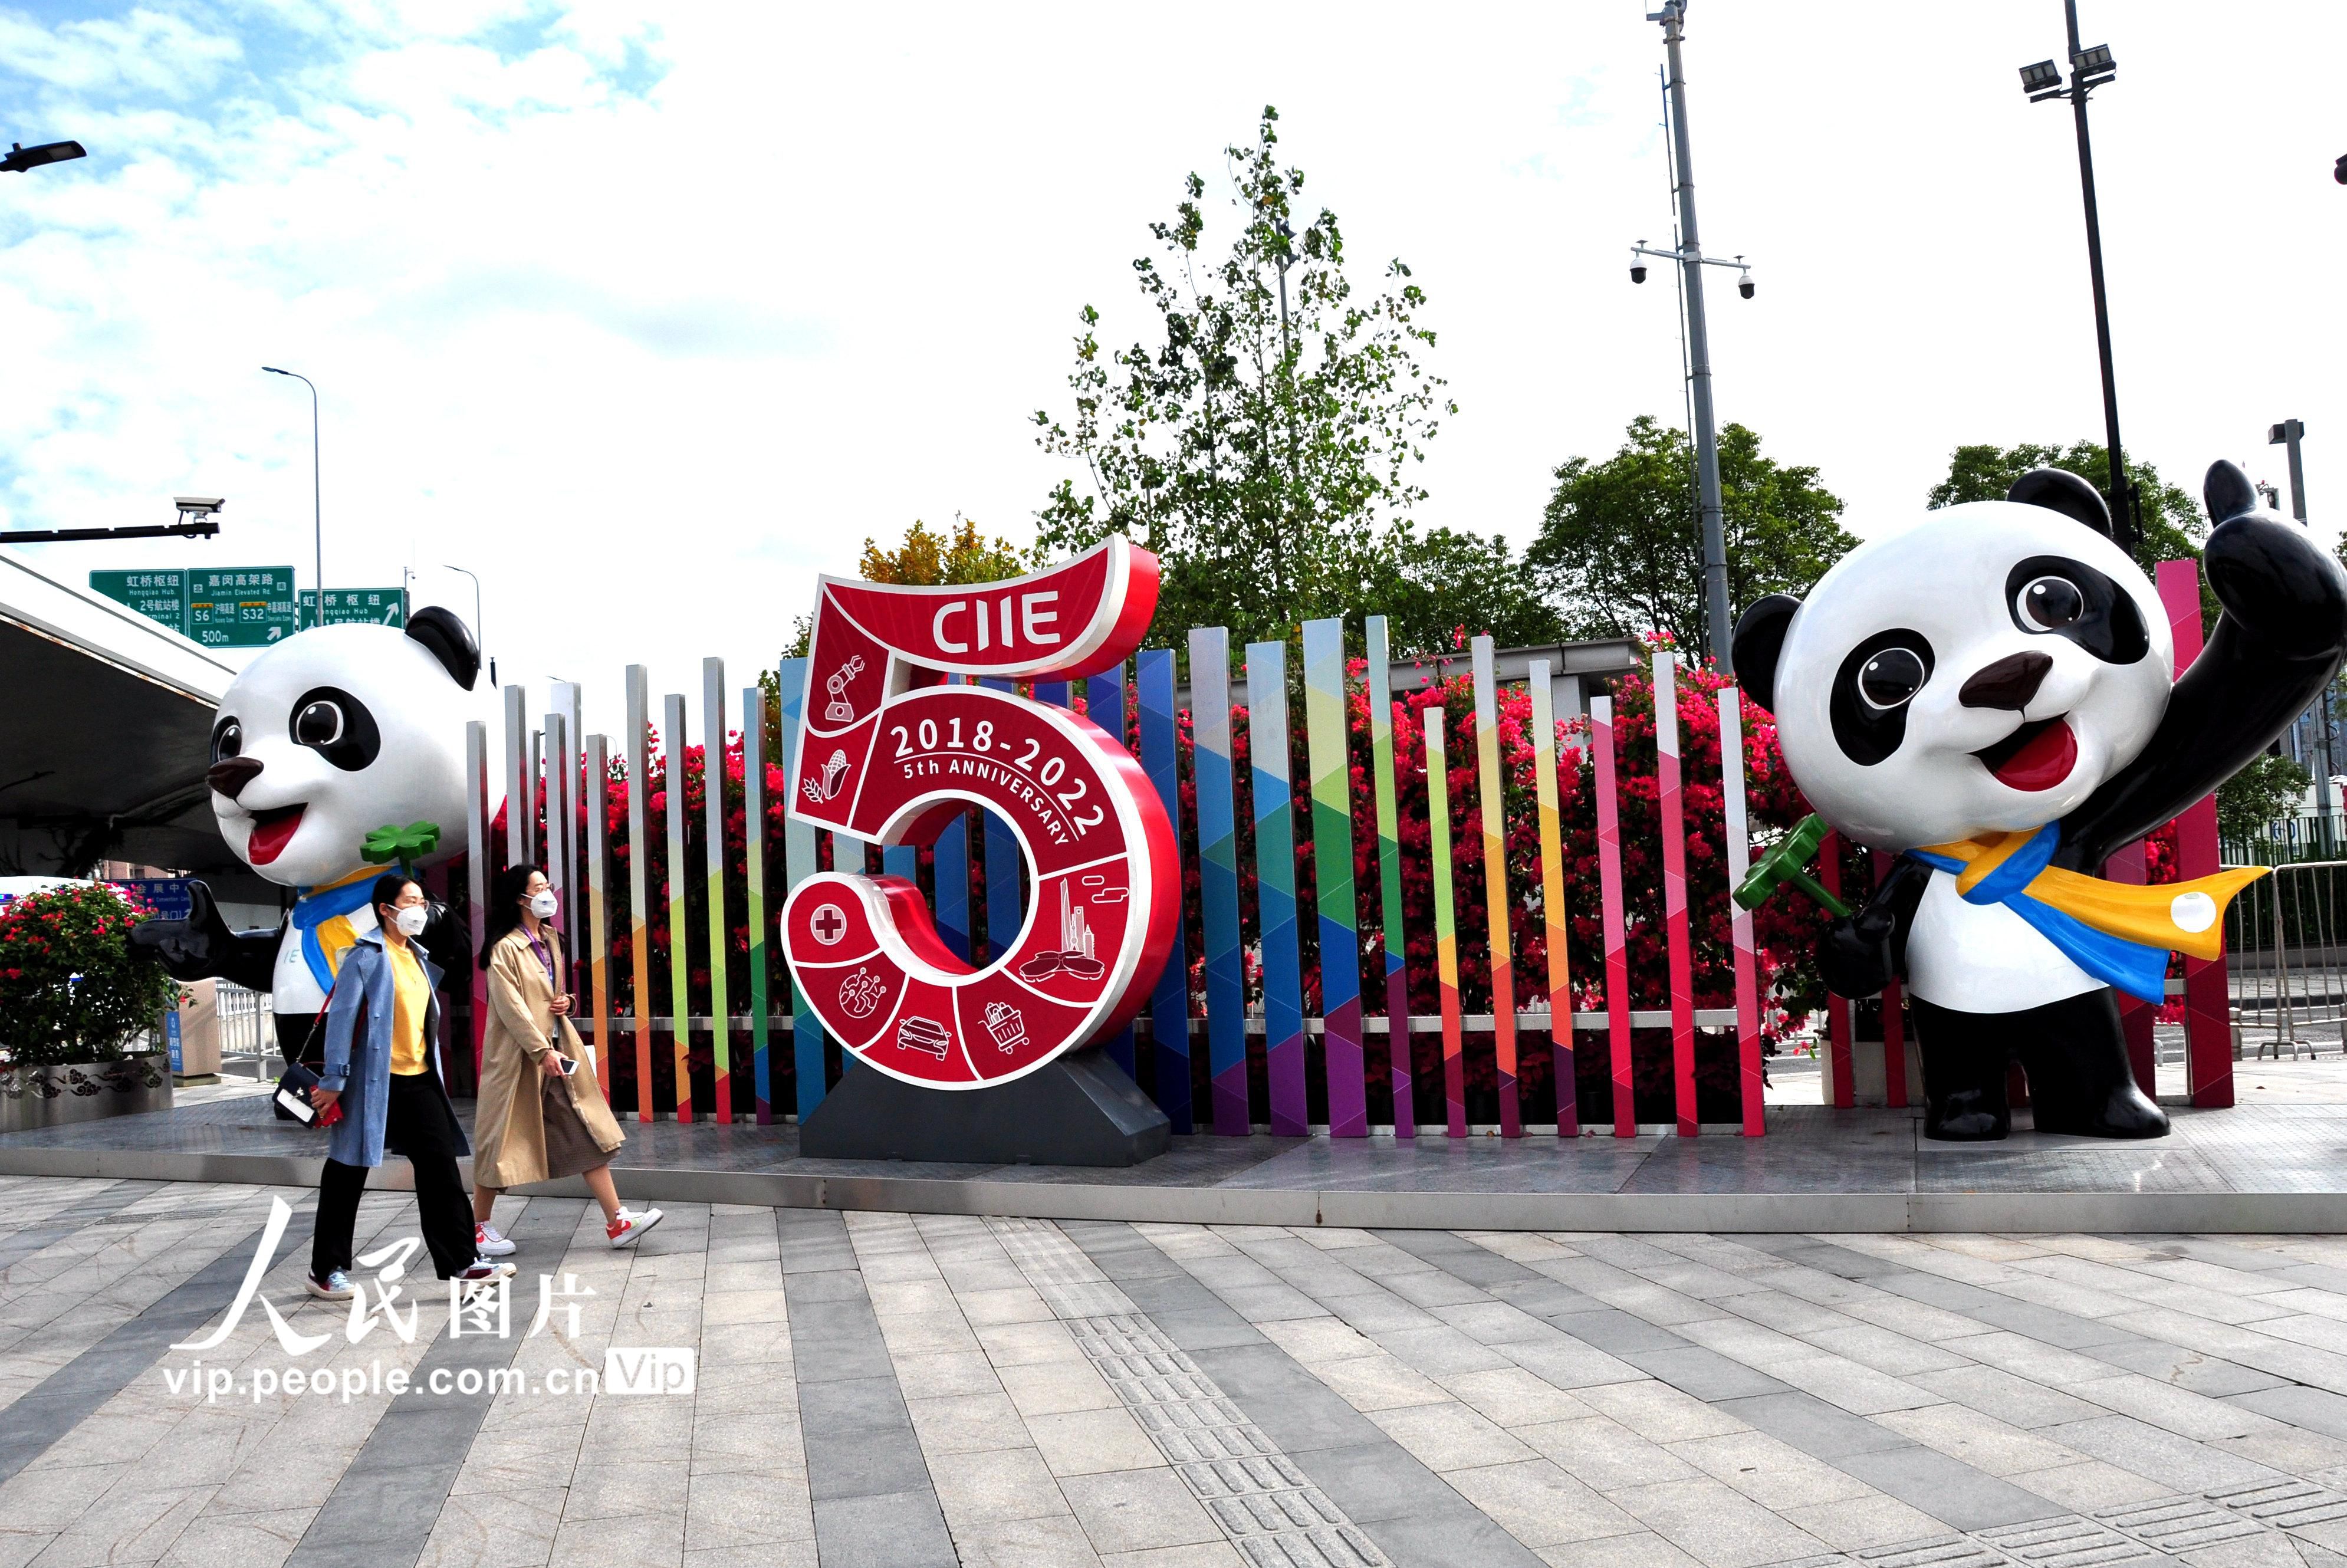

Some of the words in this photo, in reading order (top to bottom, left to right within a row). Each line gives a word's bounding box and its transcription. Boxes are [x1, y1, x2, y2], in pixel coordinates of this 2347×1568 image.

[127, 575, 179, 587] 虹桥枢纽
[209, 574, 273, 586] 嘉闵高架路
[140, 599, 179, 611] 2号航站楼
[303, 594, 380, 607] 虹桥枢纽
[195, 610, 209, 622] S6
[242, 609, 264, 620] S32
[933, 590, 1060, 653] CIIE
[202, 630, 229, 643] 500m
[890, 717, 1104, 838] 2018-2022
[904, 760, 939, 779] 5th
[949, 759, 1069, 846] ANNIVERSARY
[138, 883, 188, 893] 会展中
